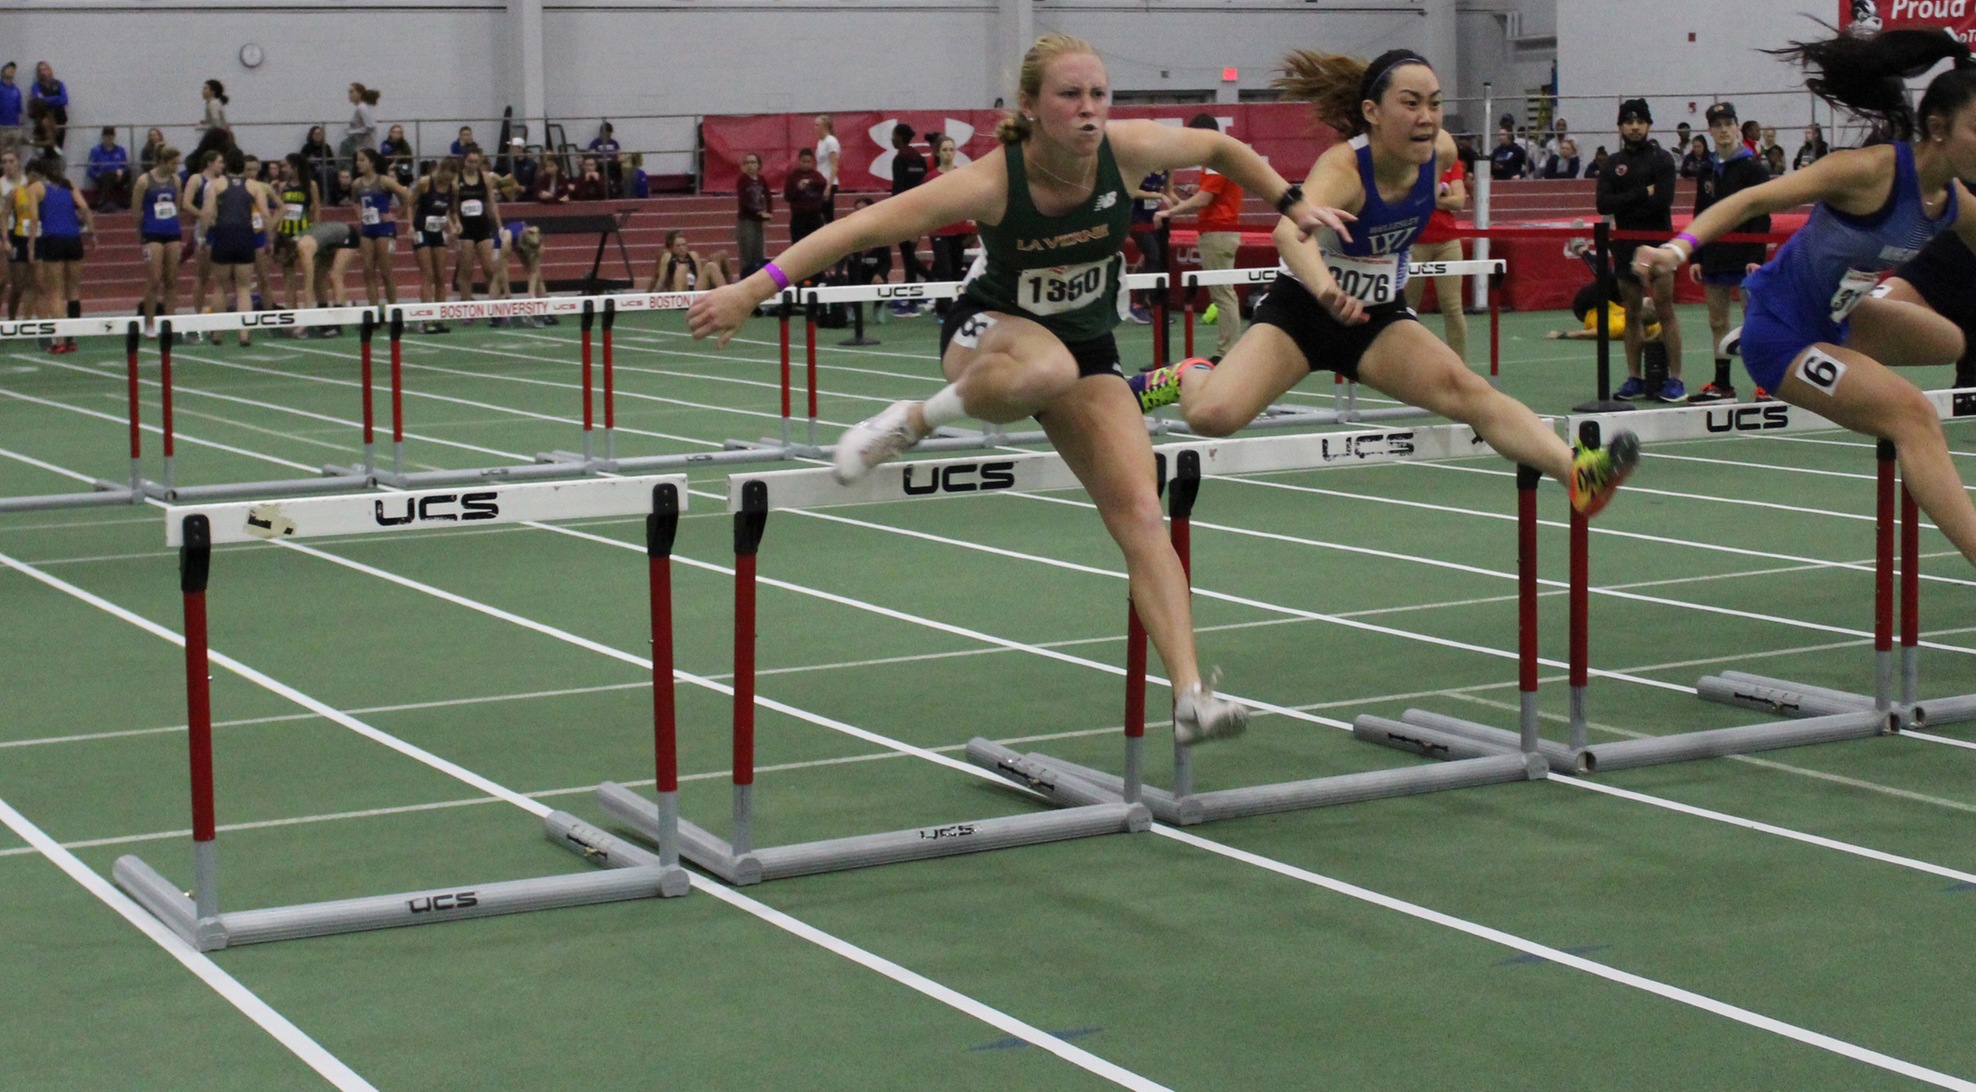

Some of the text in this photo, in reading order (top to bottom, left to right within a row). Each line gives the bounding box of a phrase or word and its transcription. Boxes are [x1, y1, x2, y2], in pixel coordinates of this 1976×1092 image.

[1891, 0, 1966, 19] Proud
[1017, 224, 1110, 252] LA VERNE
[1248, 270, 1280, 281] UC
[1408, 263, 1447, 275] UCS
[877, 285, 924, 298] UCS
[1028, 266, 1101, 304] 1350
[440, 304, 485, 319] BOSTON
[487, 301, 548, 317] UNIVERSITY
[649, 295, 690, 309] BOSTON
[241, 312, 296, 327] UCS
[0, 322, 57, 337] UCS
[1706, 405, 1789, 433] UCS
[1321, 432, 1415, 463] UCS
[903, 461, 1016, 496] UCS
[374, 491, 500, 527] UCS
[919, 824, 976, 840] UCS
[407, 891, 478, 914] UCS
